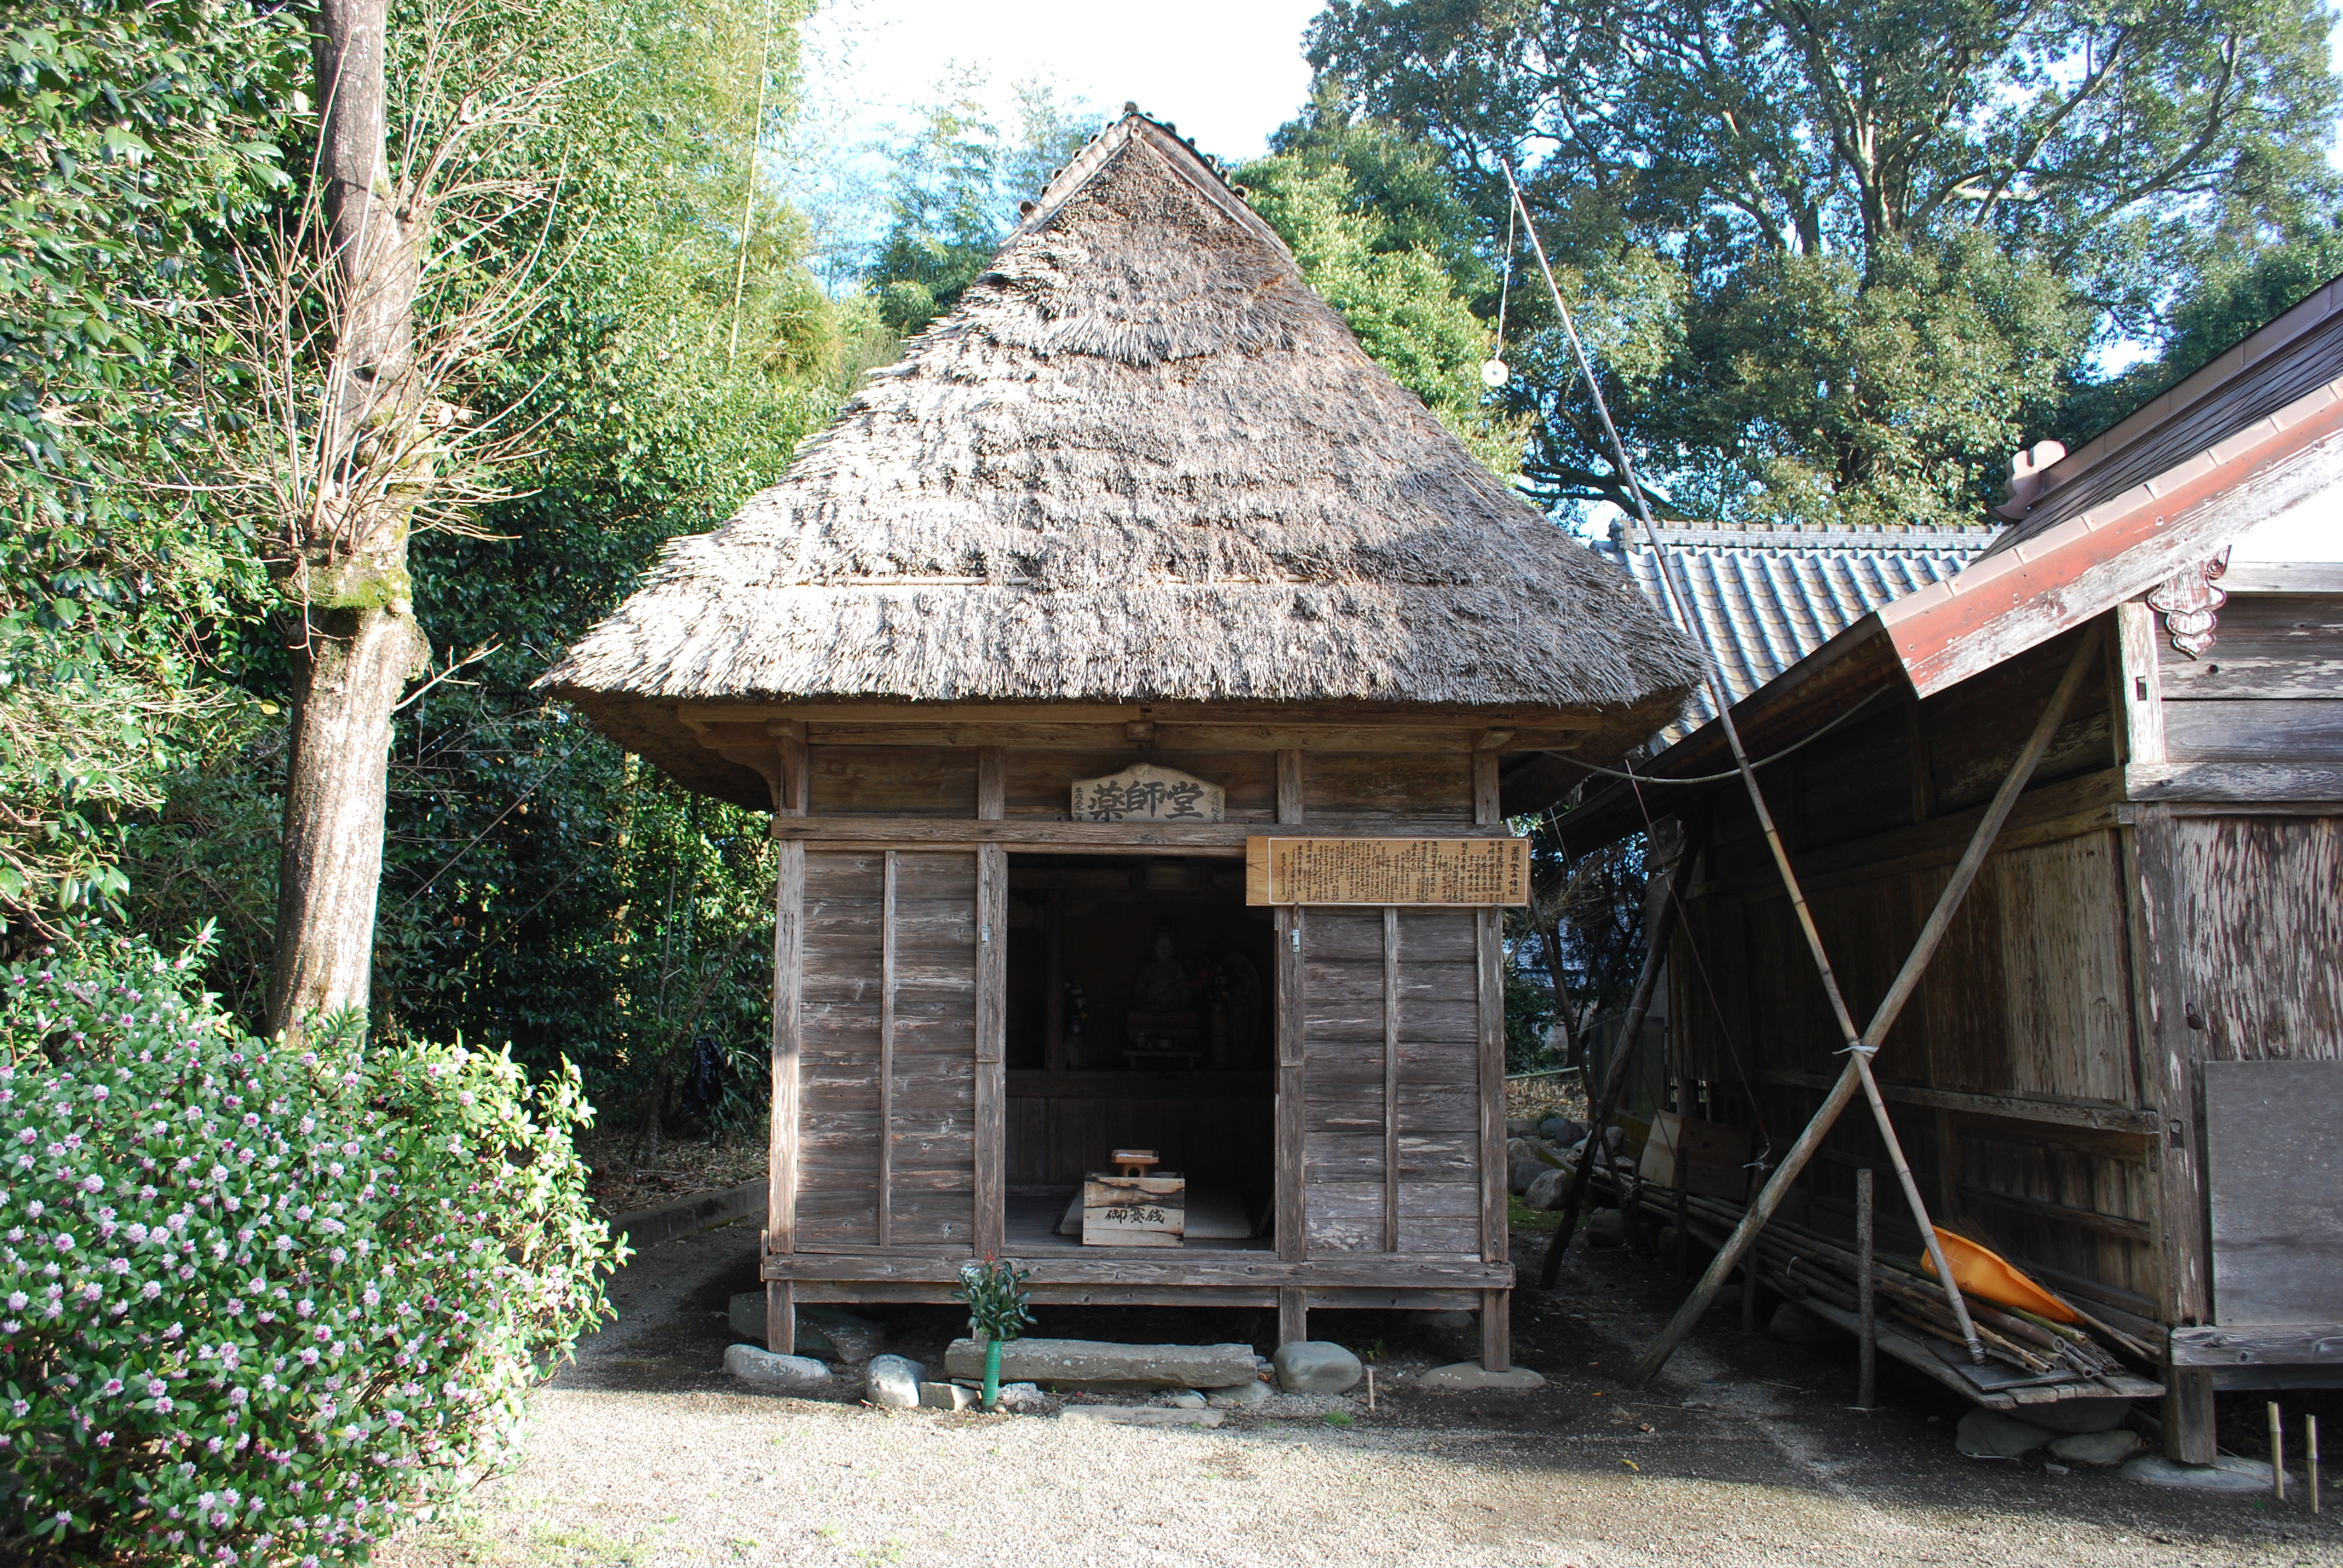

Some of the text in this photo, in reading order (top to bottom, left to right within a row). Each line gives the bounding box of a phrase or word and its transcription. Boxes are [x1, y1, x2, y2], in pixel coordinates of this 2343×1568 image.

[1088, 780, 1204, 822] 薬師堂
[1104, 1207, 1165, 1224] 御賽銭
